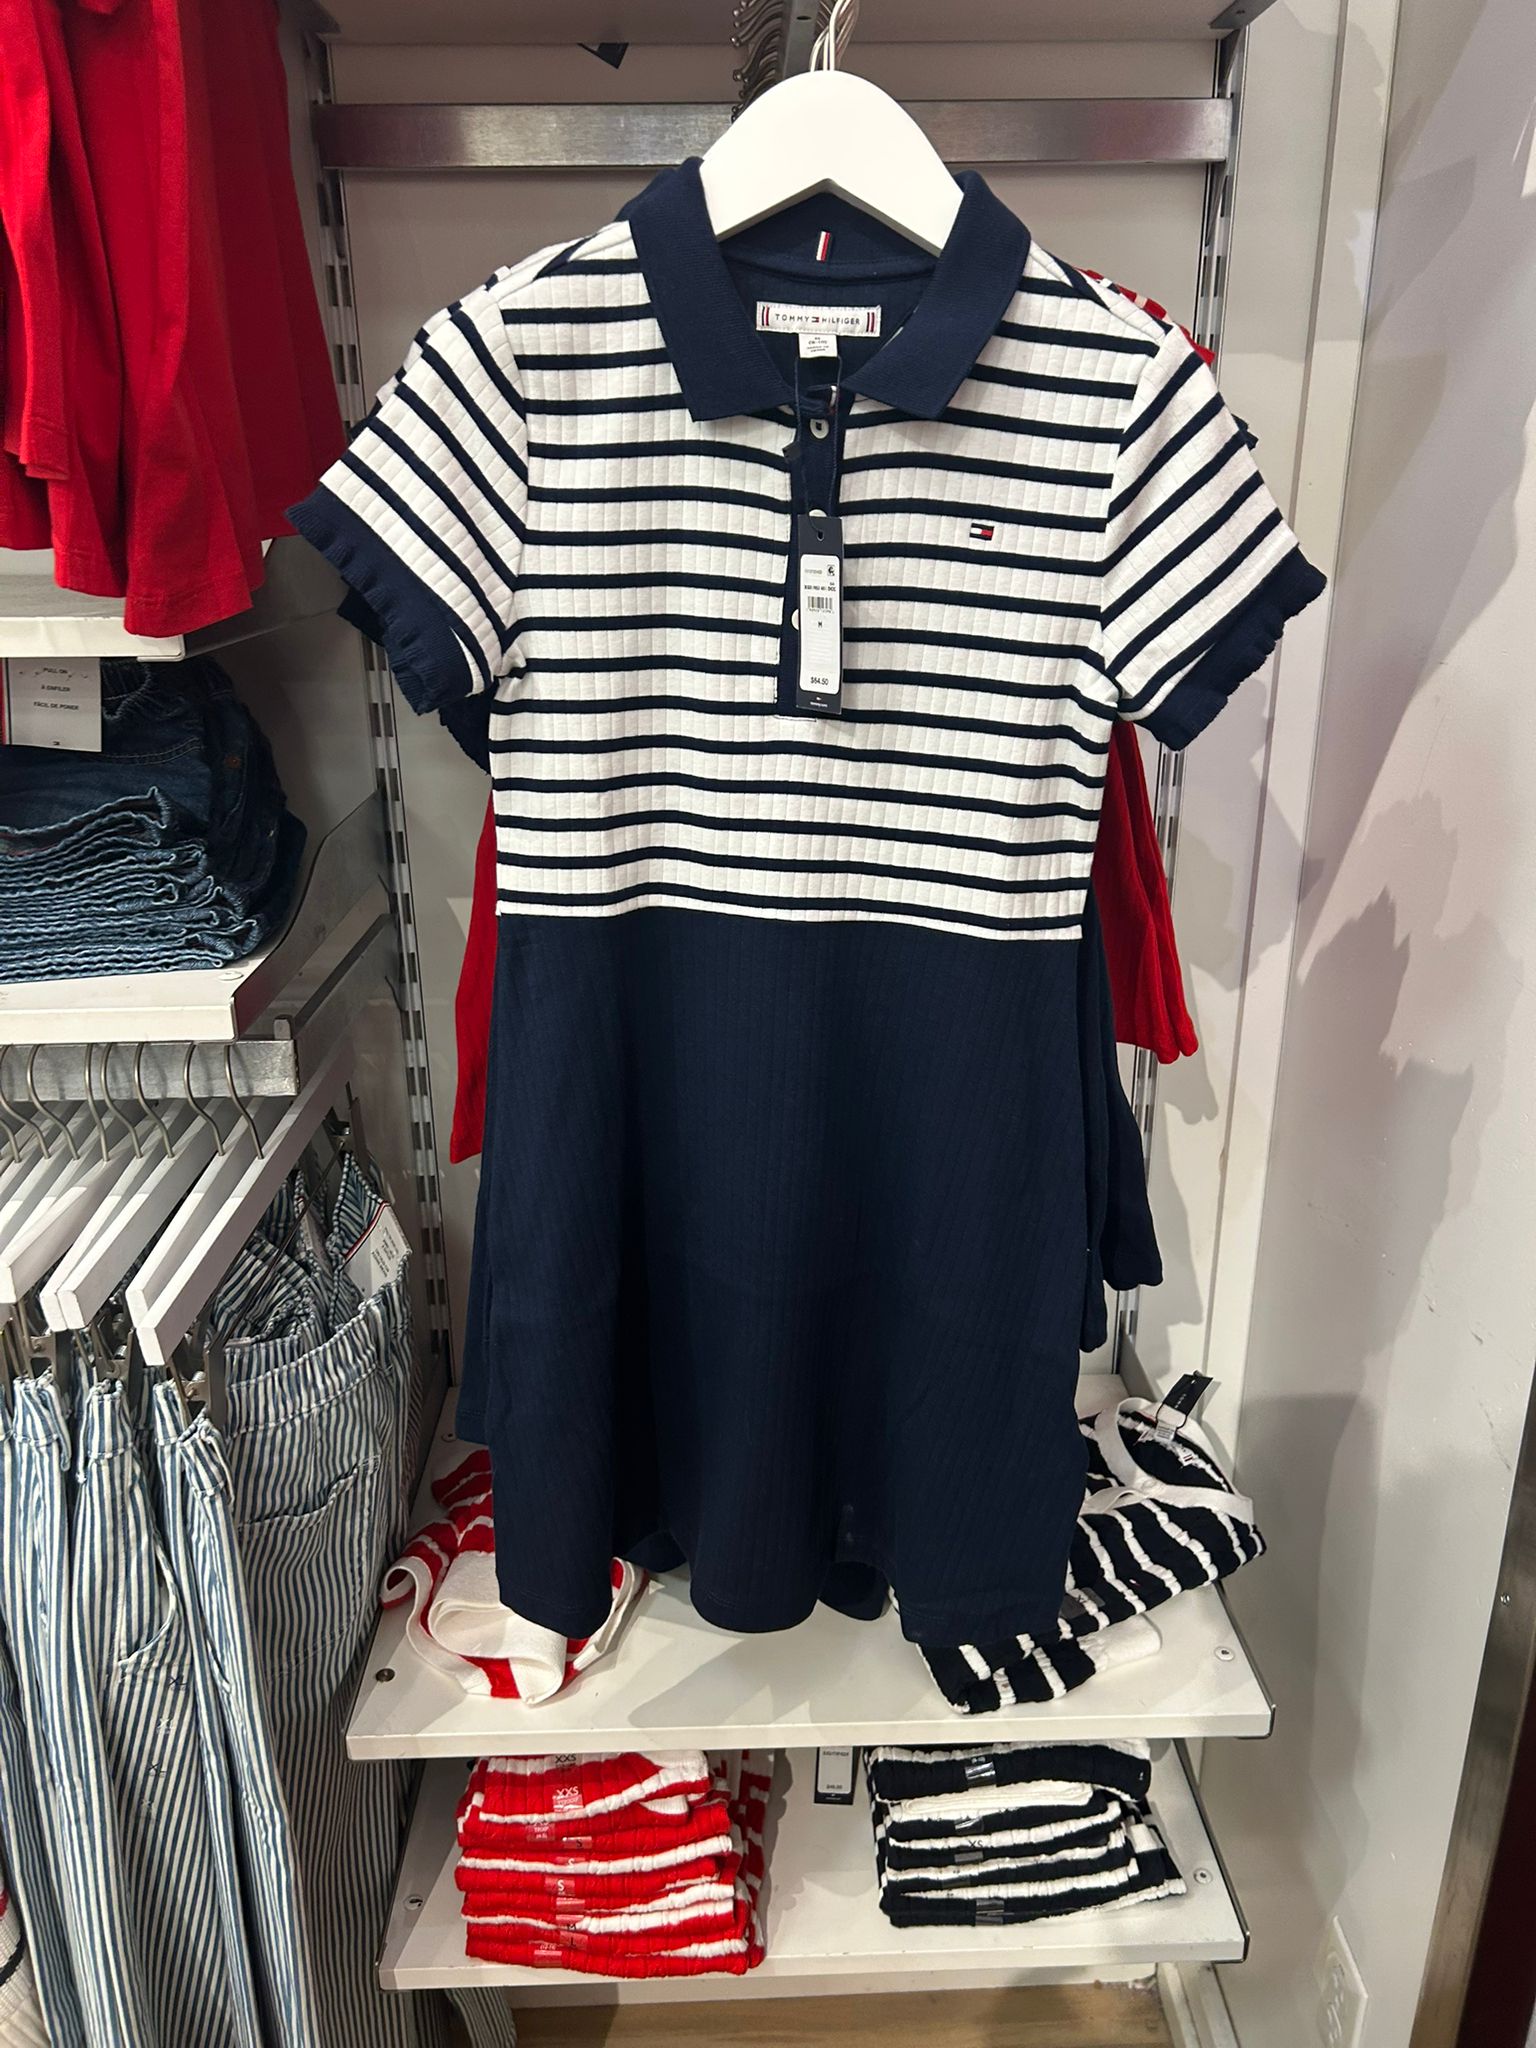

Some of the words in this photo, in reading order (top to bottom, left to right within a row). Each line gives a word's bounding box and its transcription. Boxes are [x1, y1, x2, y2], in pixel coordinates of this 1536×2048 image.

[775, 313, 810, 322] TOMMY
[822, 317, 860, 325] HILFIGER
[555, 1753, 577, 1763] XXS
[556, 1786, 579, 1797] XXS
[968, 1839, 984, 1848] XS
[557, 1879, 565, 1892] S
